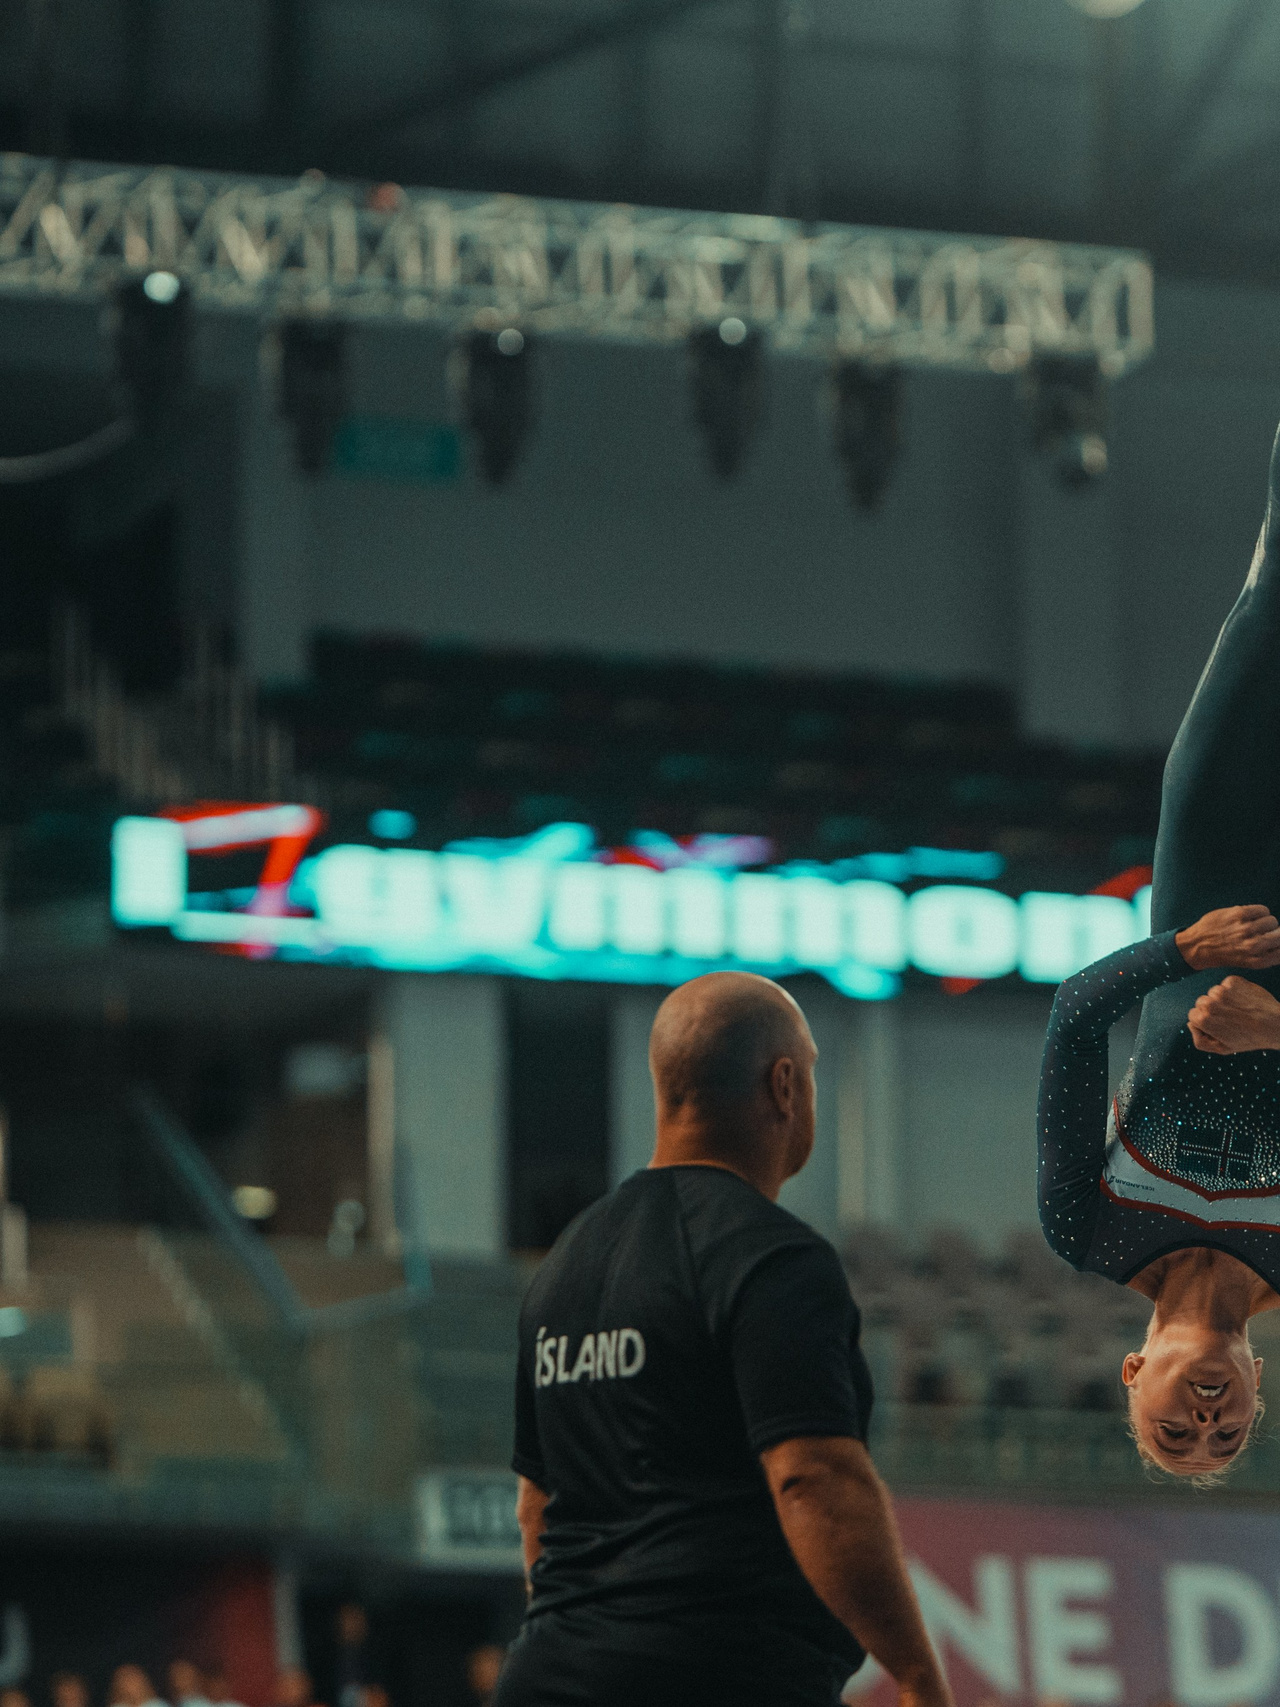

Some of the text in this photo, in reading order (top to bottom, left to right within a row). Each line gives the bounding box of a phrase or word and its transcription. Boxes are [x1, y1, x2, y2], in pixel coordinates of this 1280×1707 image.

[1115, 1178, 1155, 1191] ICELANDAIR
[534, 1325, 646, 1389] ÍSLAND
[840, 1553, 1124, 1703] NE
